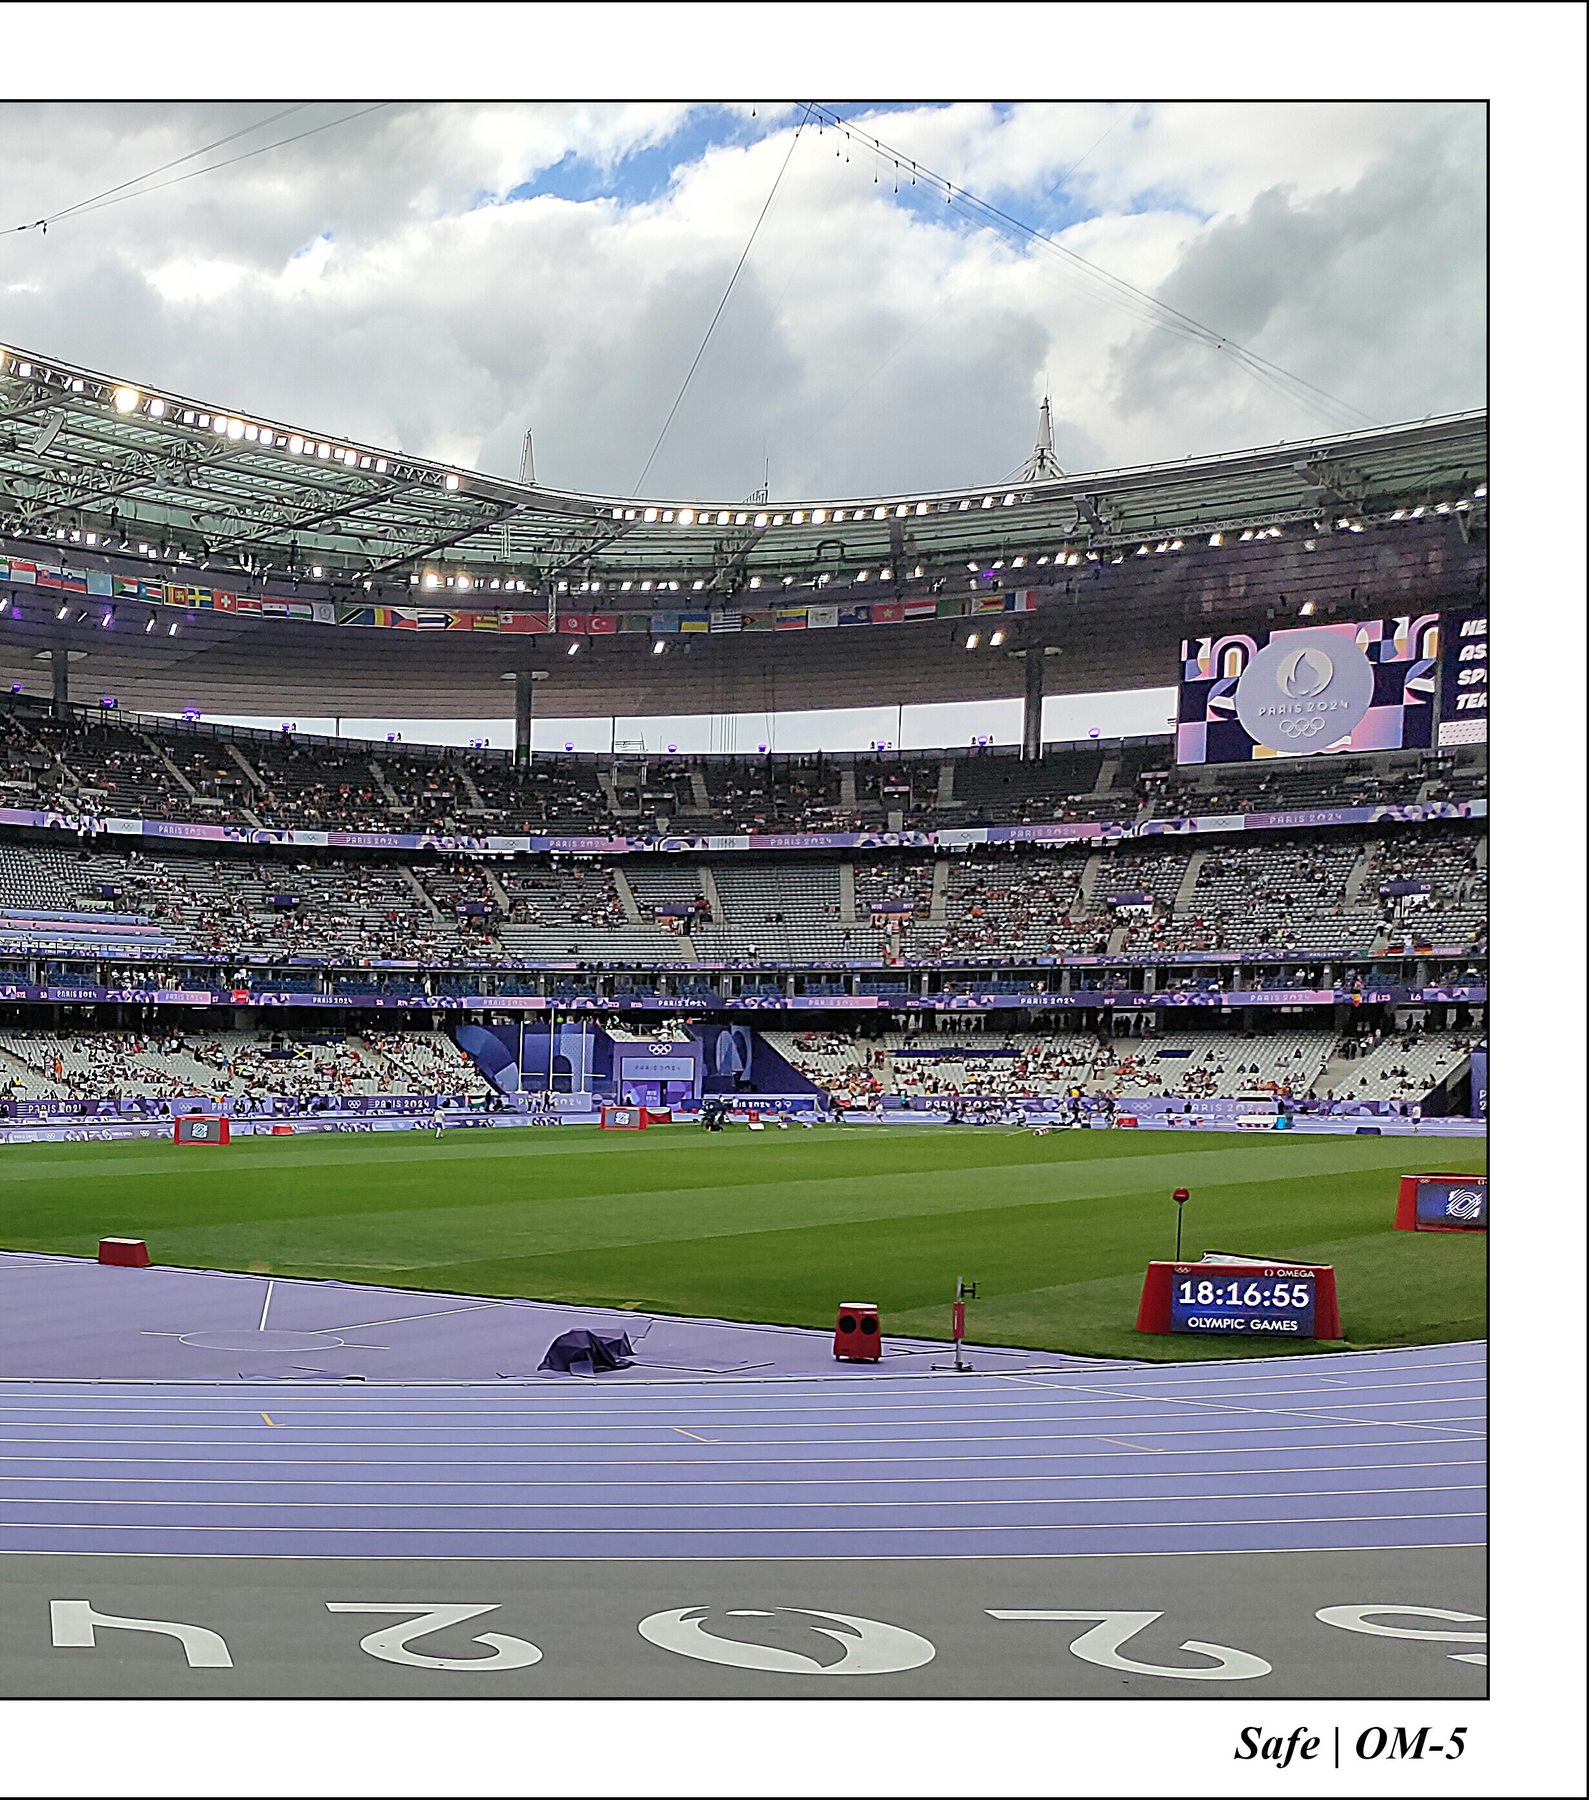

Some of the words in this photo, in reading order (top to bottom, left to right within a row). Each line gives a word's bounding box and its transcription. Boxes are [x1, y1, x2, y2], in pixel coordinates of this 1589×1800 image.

[1259, 703, 1302, 717] PARIS
[1307, 700, 1350, 712] 2024
[1270, 814, 1306, 824] PARIS
[1310, 812, 1342, 822] 2024
[158, 825, 182, 835] PARIS
[184, 827, 207, 837] 2024
[1011, 830, 1042, 838] PARIS
[1046, 828, 1076, 837] 2024
[346, 836, 372, 844] PARIS
[374, 838, 398, 846] 2024
[550, 840, 577, 848] PARIS
[581, 840, 607, 848] 2024
[770, 838, 799, 846] PARIS
[803, 838, 832, 846] 2024
[57, 990, 78, 998] PARIS
[79, 990, 98, 998] 2024
[404, 1100, 430, 1108] 2024
[1277, 1269, 1314, 1278] OMEGA
[1178, 1280, 1310, 1308] 18:16:55
[1188, 1316, 1245, 1330] OLYMPIC
[1250, 1319, 1298, 1331] GAMES
